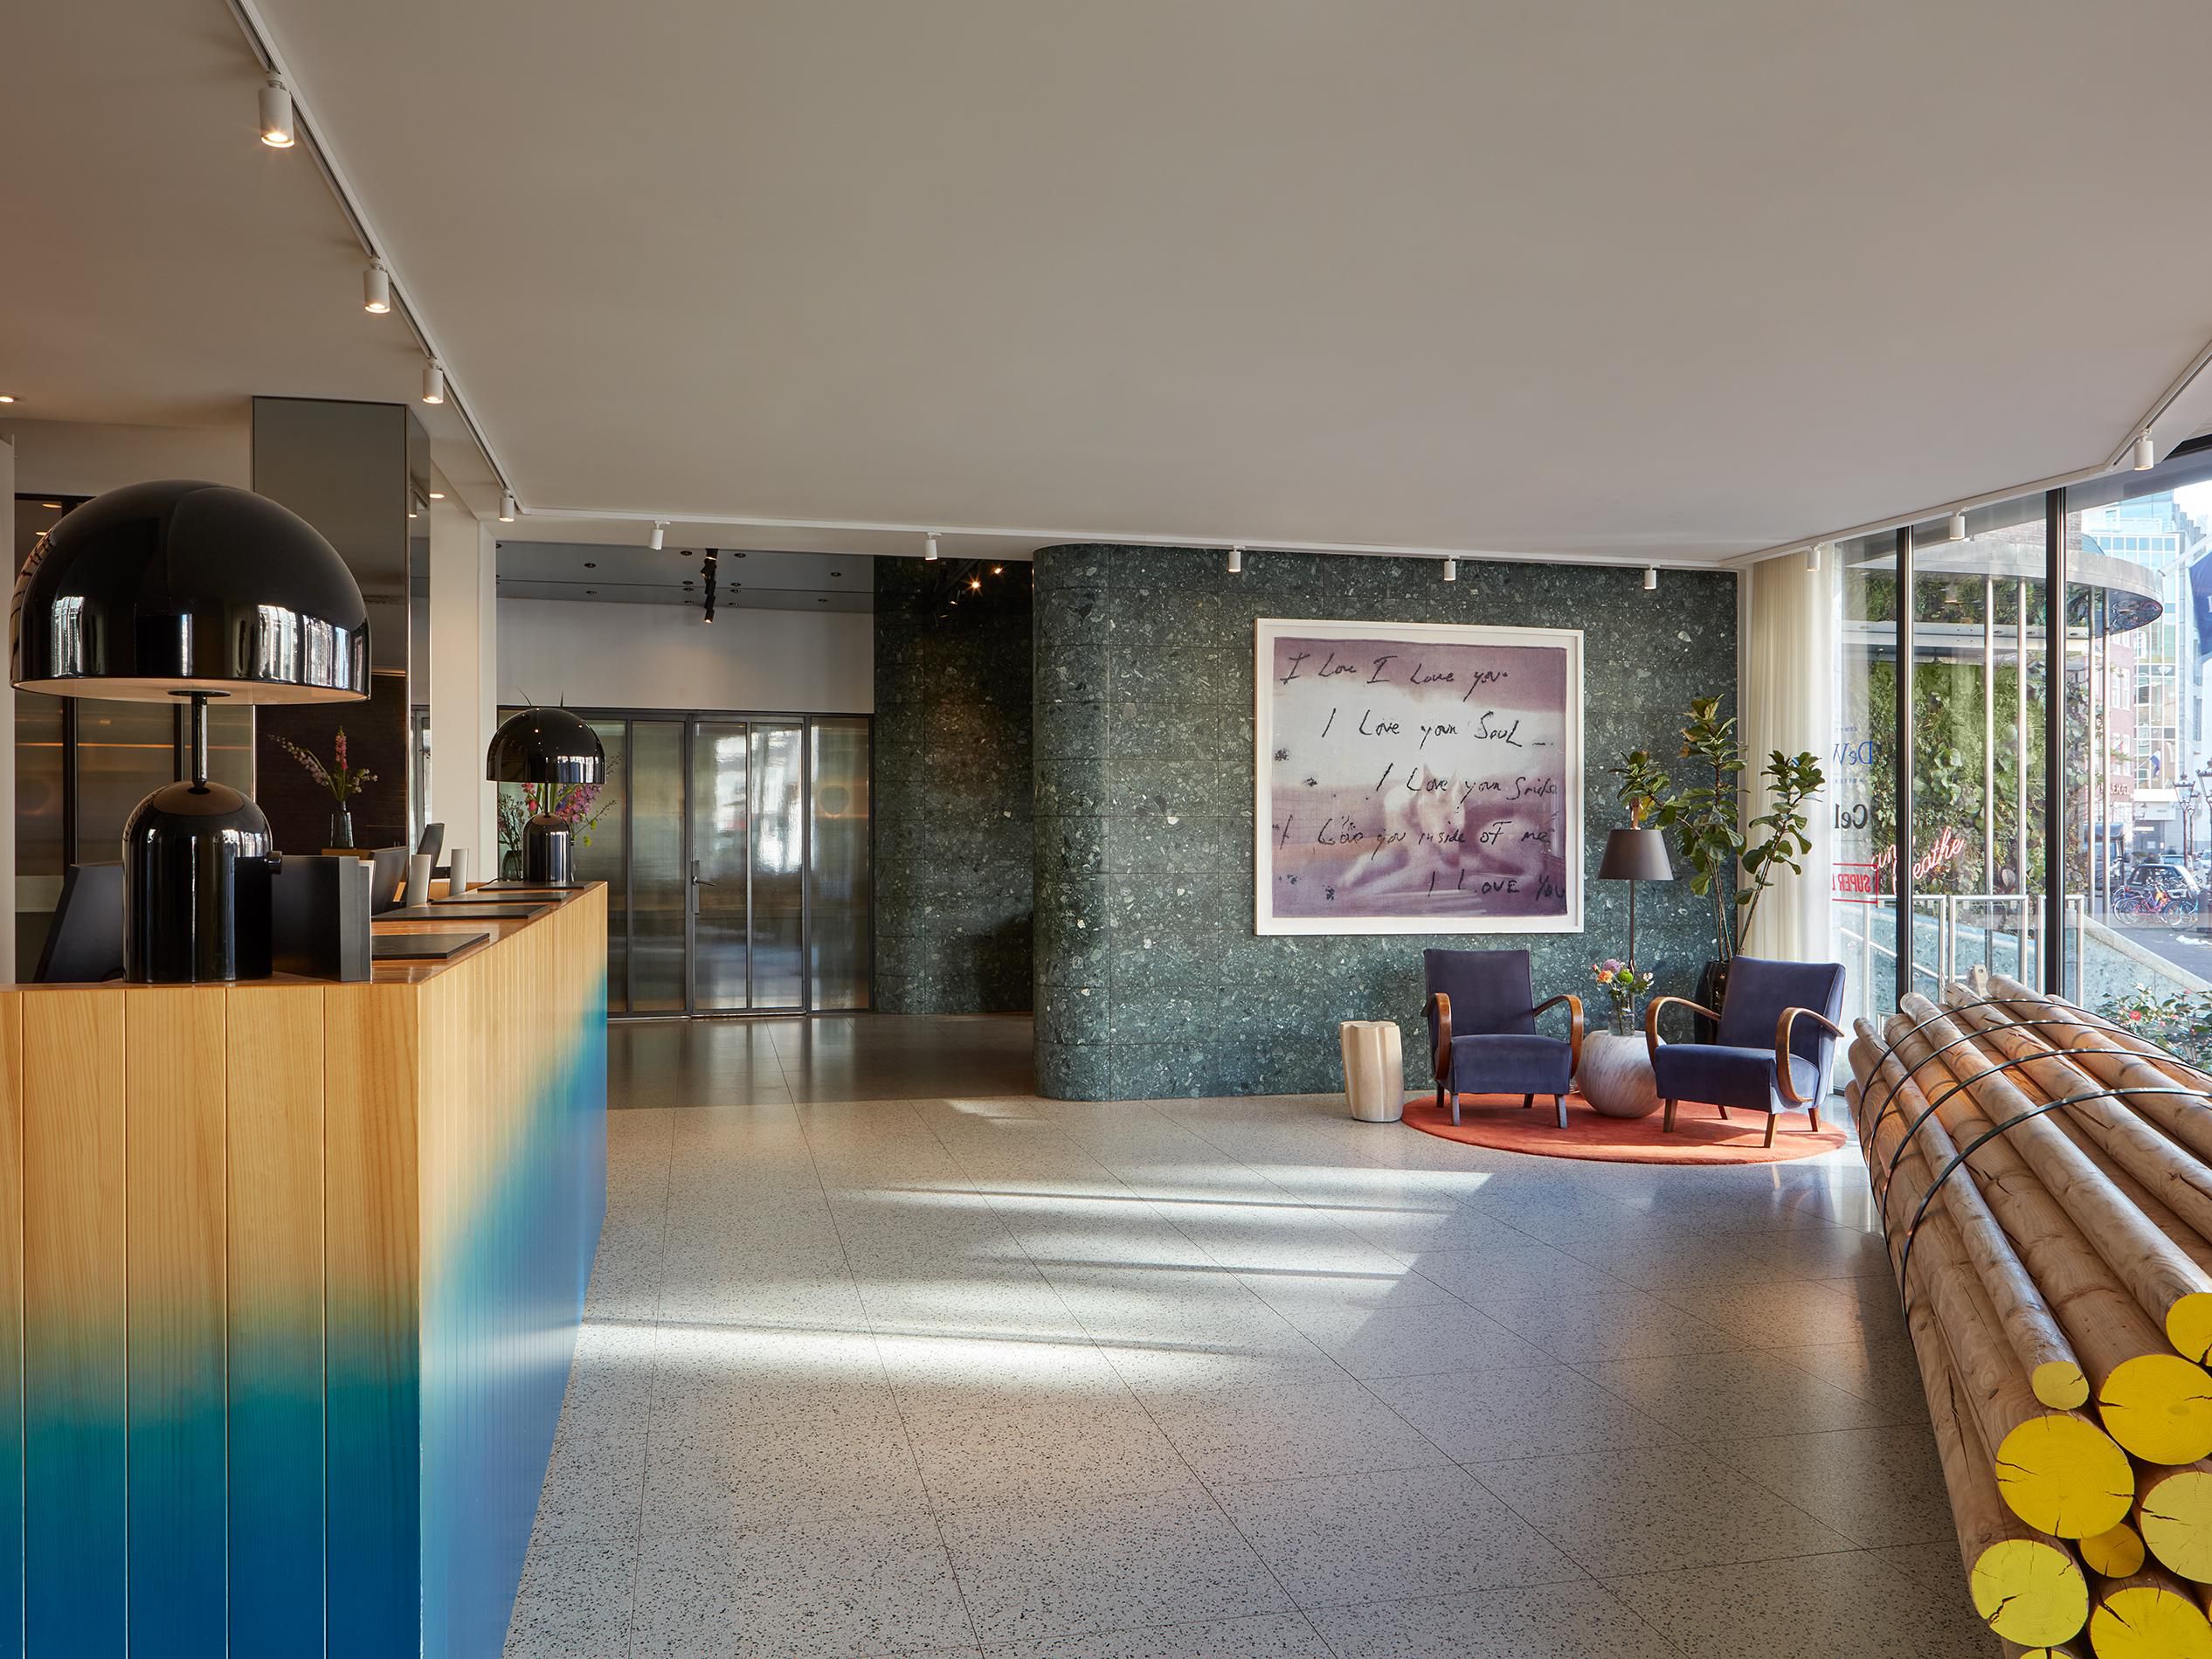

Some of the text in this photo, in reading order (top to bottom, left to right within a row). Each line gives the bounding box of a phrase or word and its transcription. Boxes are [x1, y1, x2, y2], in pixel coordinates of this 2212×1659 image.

[1280, 653, 1310, 685] I
[1366, 655, 1398, 684] I
[1410, 663, 1455, 685] Love
[1322, 708, 1337, 737] I
[1358, 709, 1400, 736] Love
[1376, 763, 1393, 791] I
[1406, 767, 1448, 791] Love
[1372, 832, 1407, 861] you
[1427, 870, 1435, 897] I
